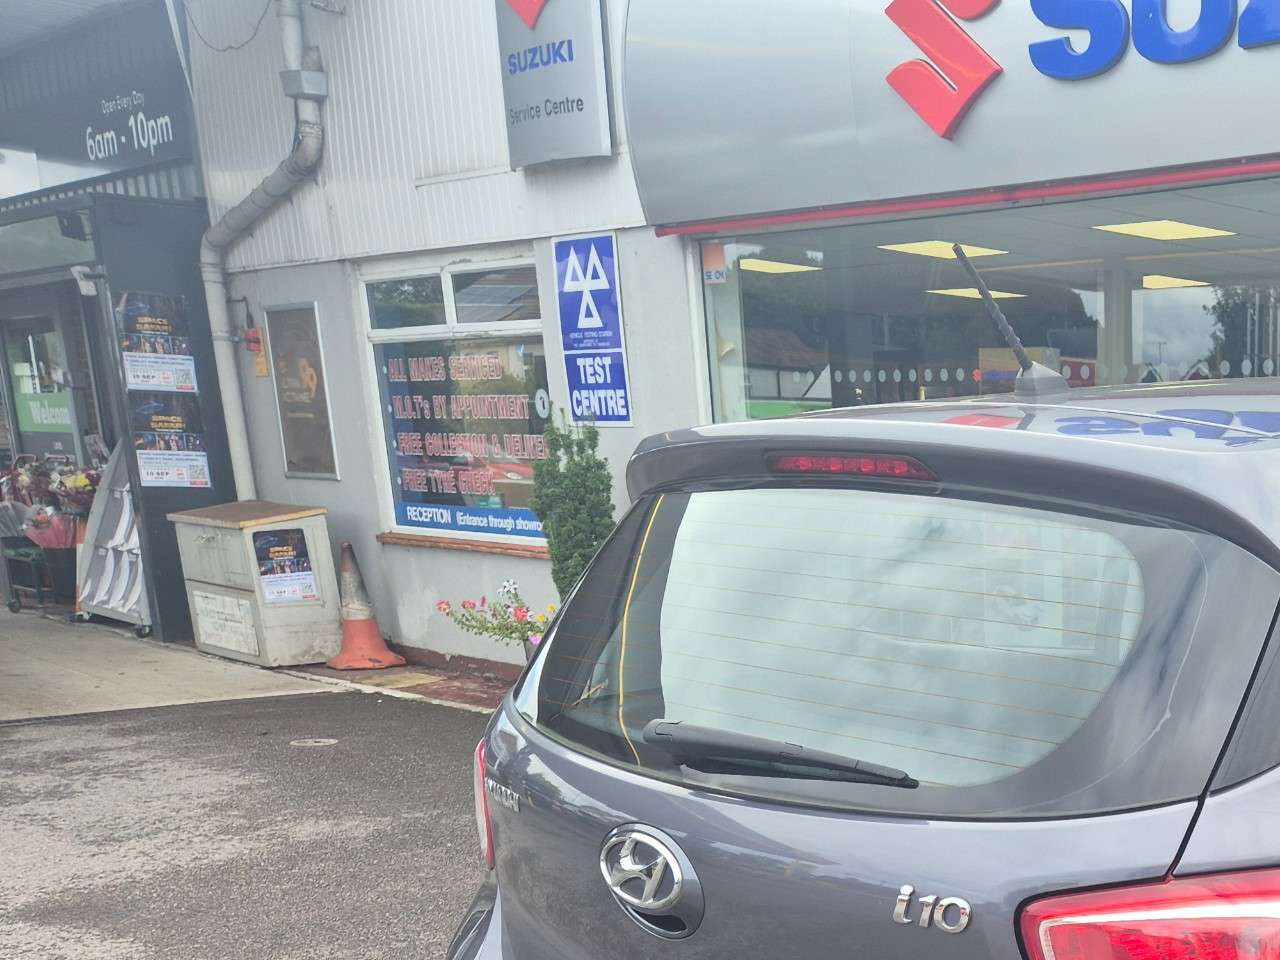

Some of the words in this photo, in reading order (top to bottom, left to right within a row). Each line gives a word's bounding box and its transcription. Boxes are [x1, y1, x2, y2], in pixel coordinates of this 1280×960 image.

[507, 39, 574, 75] SUZUKI
[509, 104, 541, 125] Service
[544, 97, 584, 116] Centre
[86, 126, 118, 160] 6am
[128, 111, 173, 157] 10pm
[388, 358, 407, 382] ALL
[408, 356, 446, 381] MAKES
[448, 354, 502, 380] SERVICED
[576, 356, 611, 384] TEST
[432, 394, 447, 419] BY
[451, 394, 530, 420] APPOINTMENT
[572, 389, 627, 416] CENTRE
[397, 432, 424, 456] FREE
[425, 432, 489, 458] COLLECTION
[491, 434, 502, 458] &
[401, 468, 428, 492] FREE
[428, 469, 457, 494] TYRE
[458, 470, 496, 496] CHECK
[406, 506, 451, 524] RECEPTION
[456, 511, 488, 527] (Entrance
[488, 514, 515, 532] through
[892, 884, 972, 934] i10
